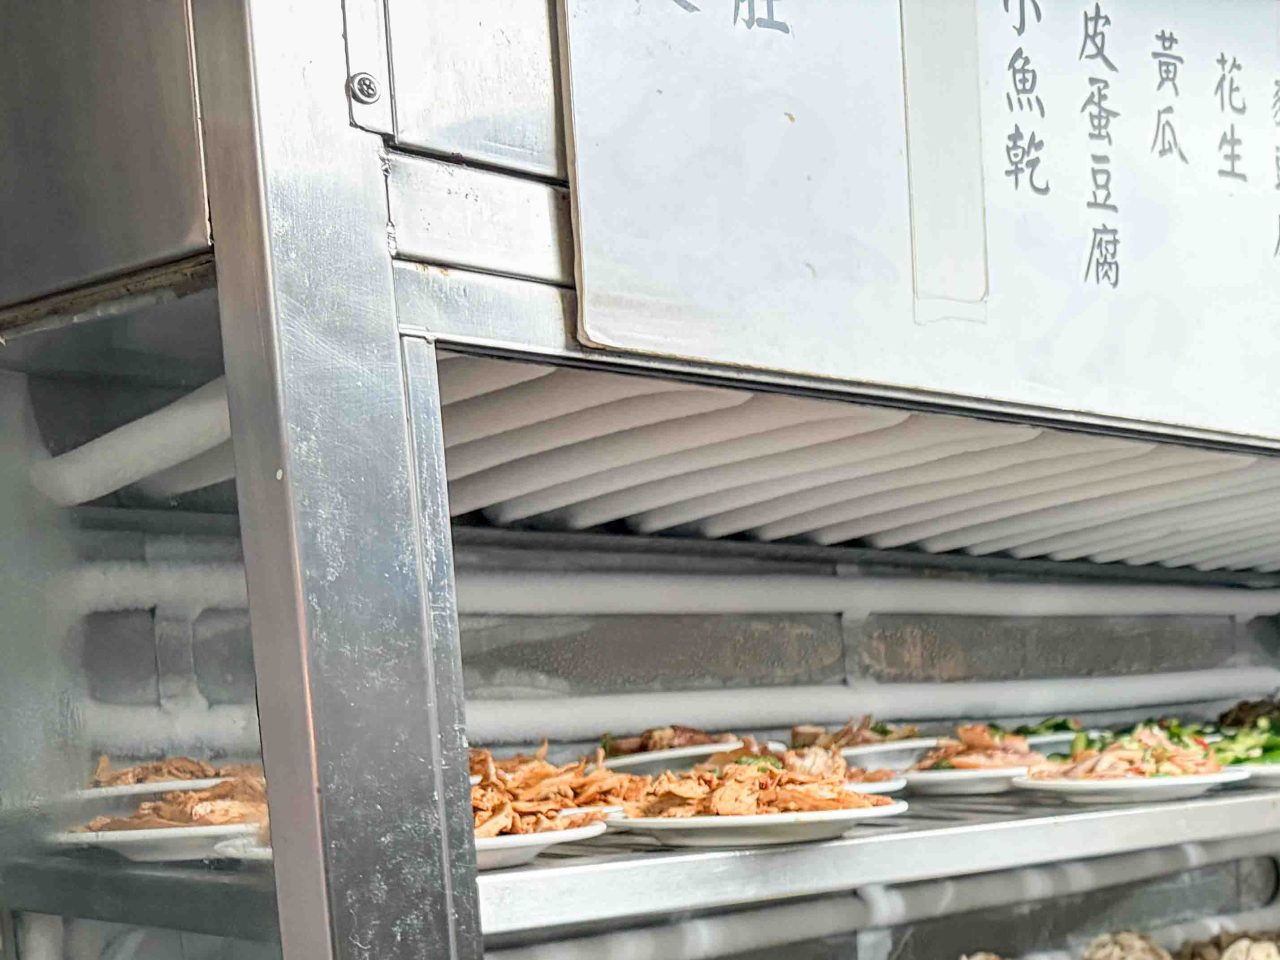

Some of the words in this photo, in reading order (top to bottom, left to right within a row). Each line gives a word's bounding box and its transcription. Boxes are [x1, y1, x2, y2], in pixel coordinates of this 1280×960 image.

[1078, 2, 1121, 289] 皮蛋豆腐
[1150, 29, 1190, 165] 黃瓜
[1213, 51, 1248, 183] 花生
